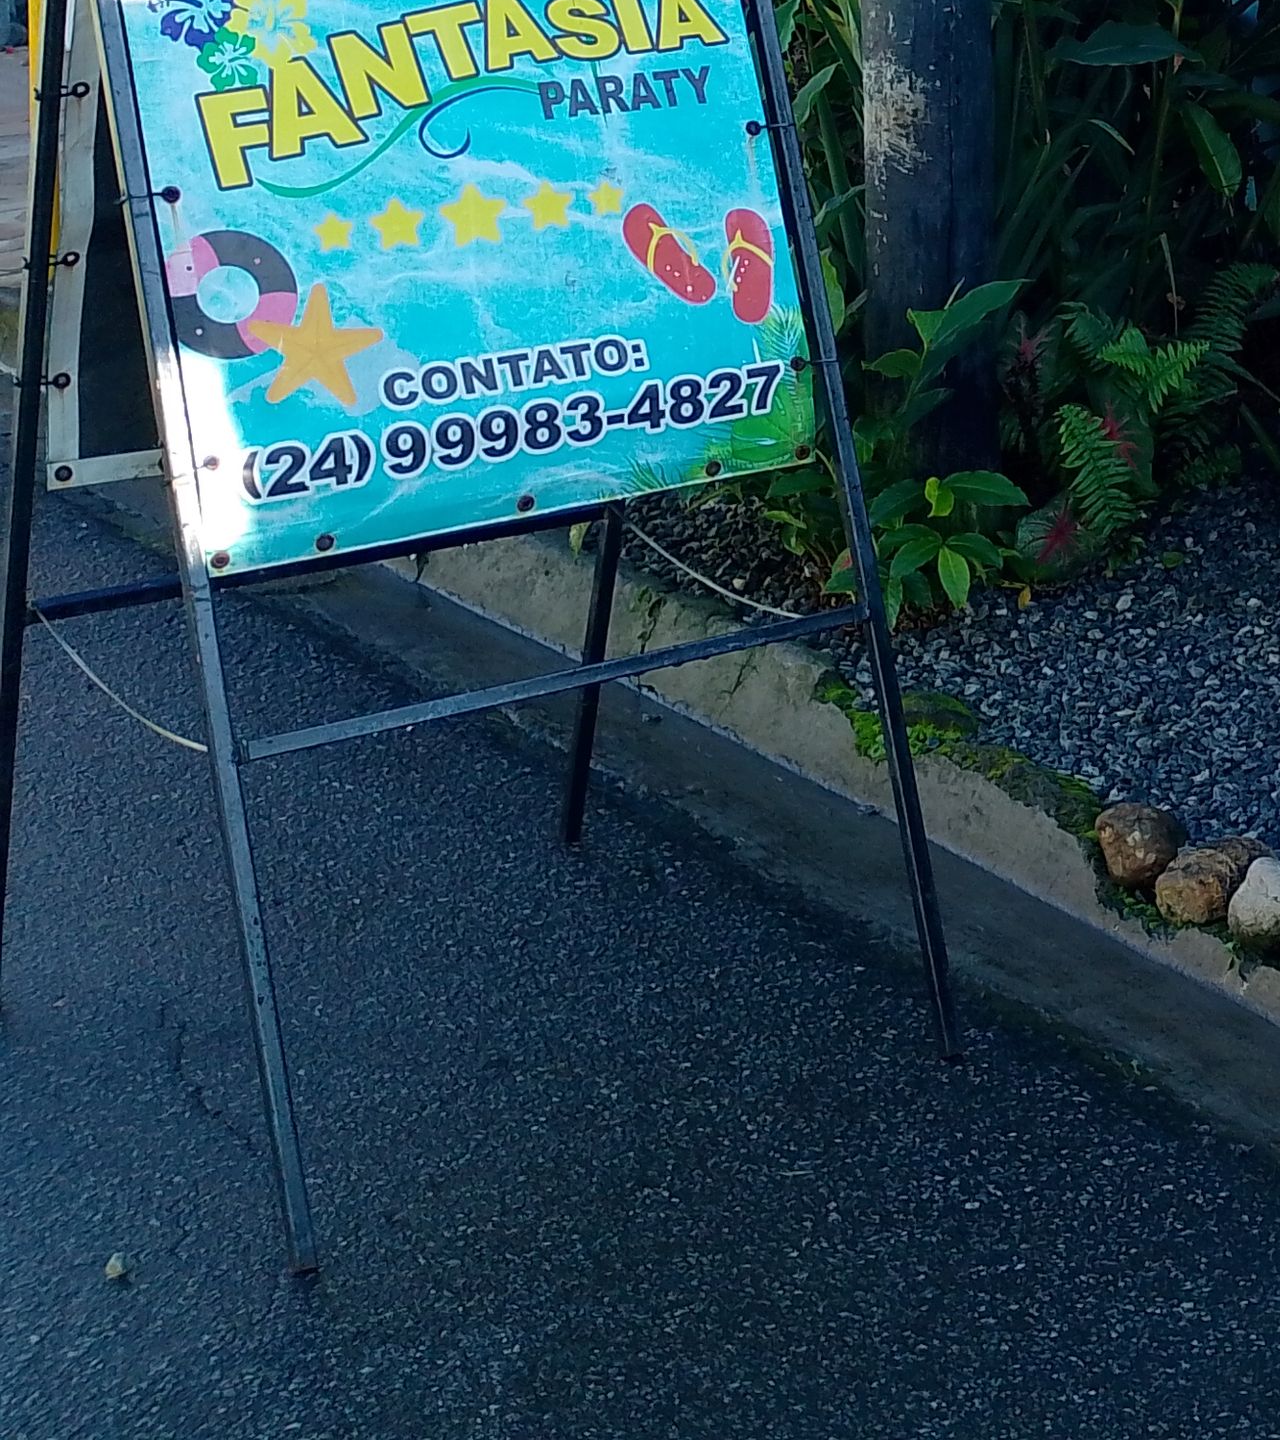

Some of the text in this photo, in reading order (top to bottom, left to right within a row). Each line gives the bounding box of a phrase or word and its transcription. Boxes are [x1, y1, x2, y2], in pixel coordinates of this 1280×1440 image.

[538, 65, 711, 120] PARATY
[383, 339, 646, 406] CONTATO:
[242, 364, 782, 500] (24) 99983-4827
